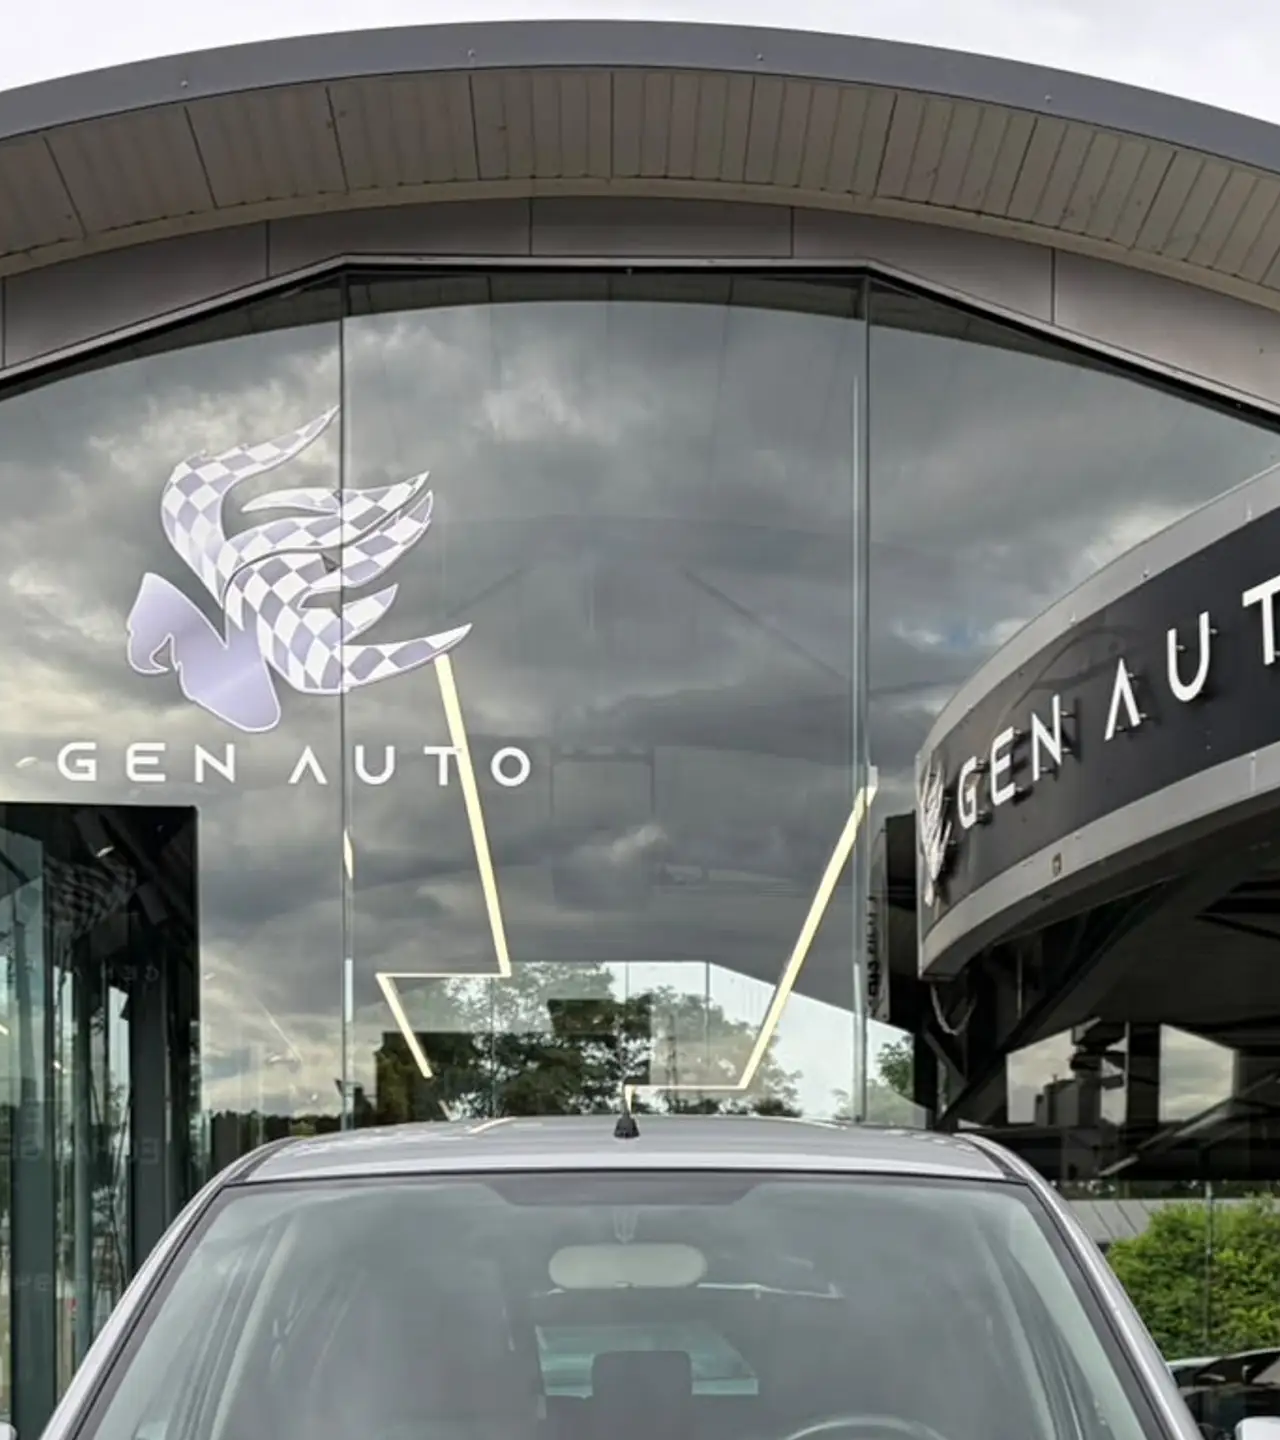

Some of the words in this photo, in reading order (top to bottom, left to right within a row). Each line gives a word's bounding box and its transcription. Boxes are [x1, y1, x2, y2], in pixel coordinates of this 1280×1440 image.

[57, 742, 236, 783] GEN
[288, 745, 531, 787] AUTO
[958, 694, 1063, 830] GEN
